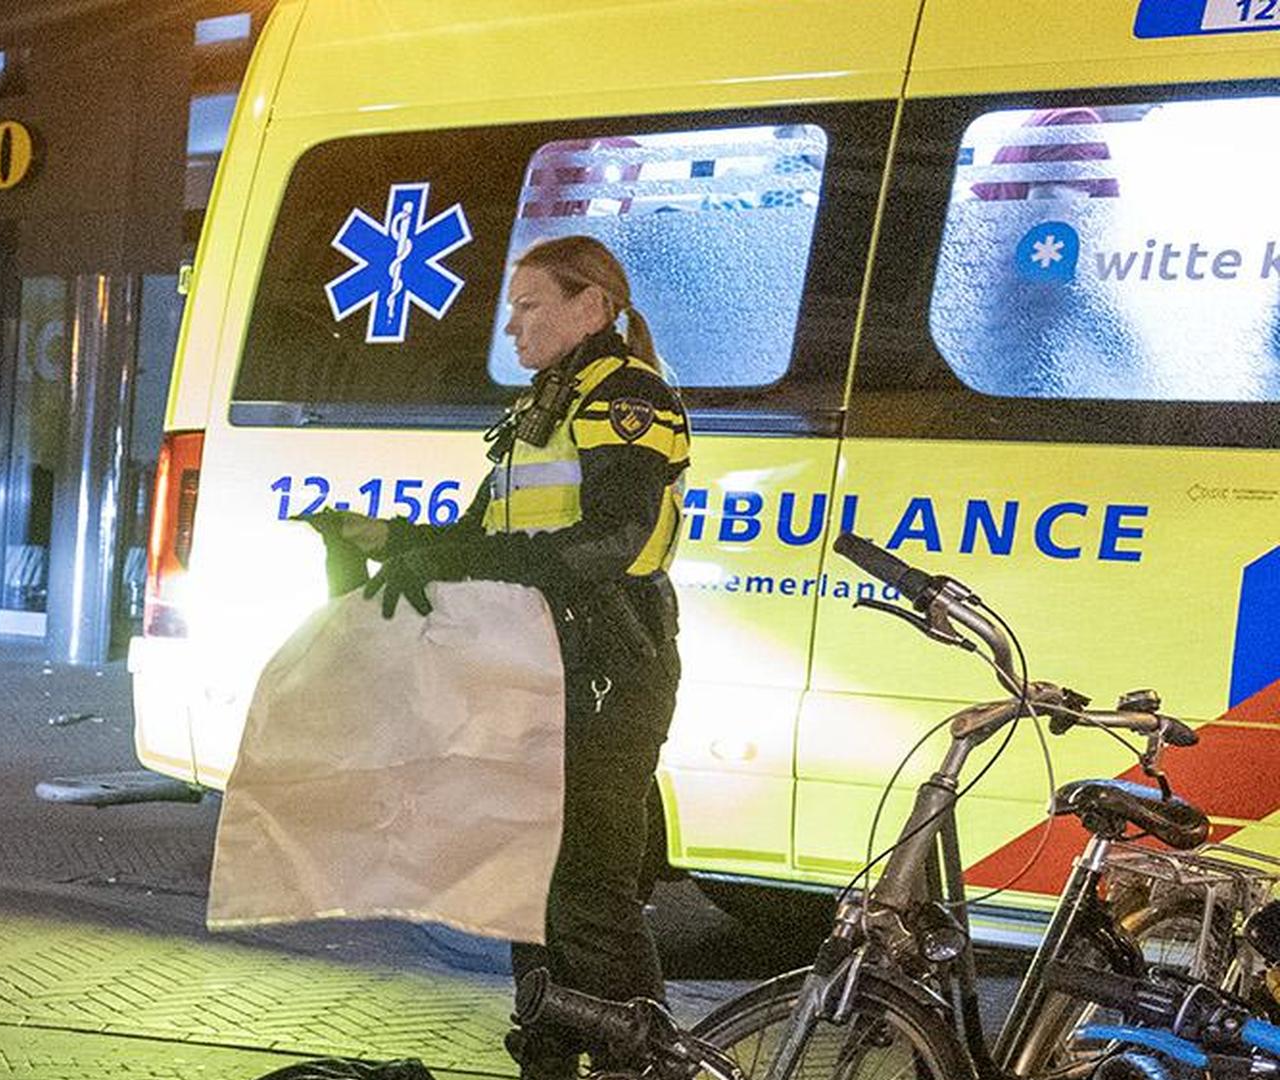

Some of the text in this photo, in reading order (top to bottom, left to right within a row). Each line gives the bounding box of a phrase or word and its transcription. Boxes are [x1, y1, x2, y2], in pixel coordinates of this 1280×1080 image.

[1096, 239, 1242, 281] witte
[271, 476, 460, 527] 12-156
[683, 489, 1149, 562] BULANCE
[682, 574, 900, 600] emerland
